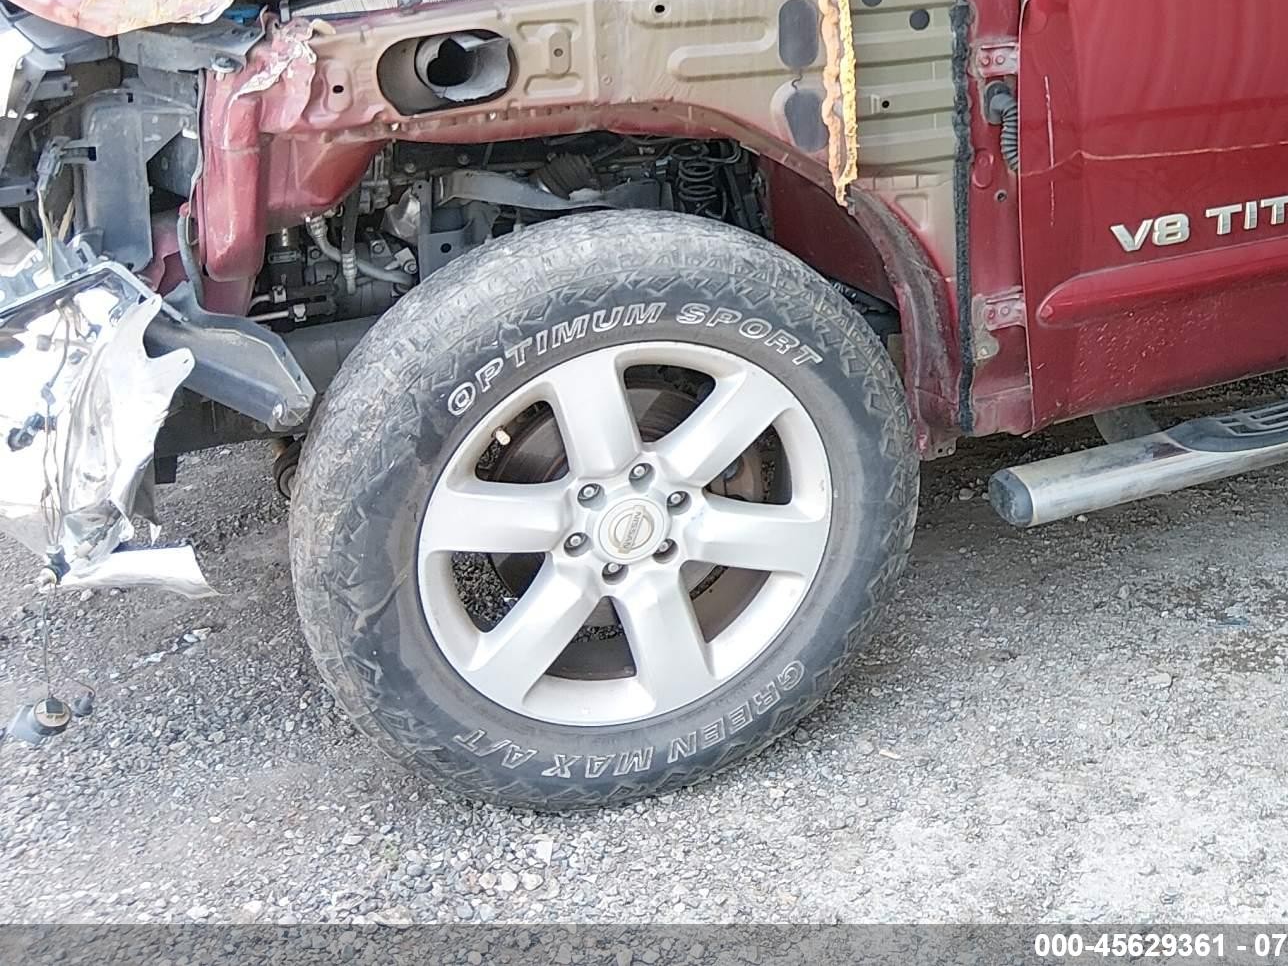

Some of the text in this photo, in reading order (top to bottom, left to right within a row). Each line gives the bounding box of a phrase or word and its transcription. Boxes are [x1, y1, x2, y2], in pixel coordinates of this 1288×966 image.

[1109, 213, 1190, 252] V8
[447, 301, 824, 417] OPTIMUM SPORT
[622, 511, 643, 550] NISSAN
[451, 659, 806, 779] GREEN MAX A/T
